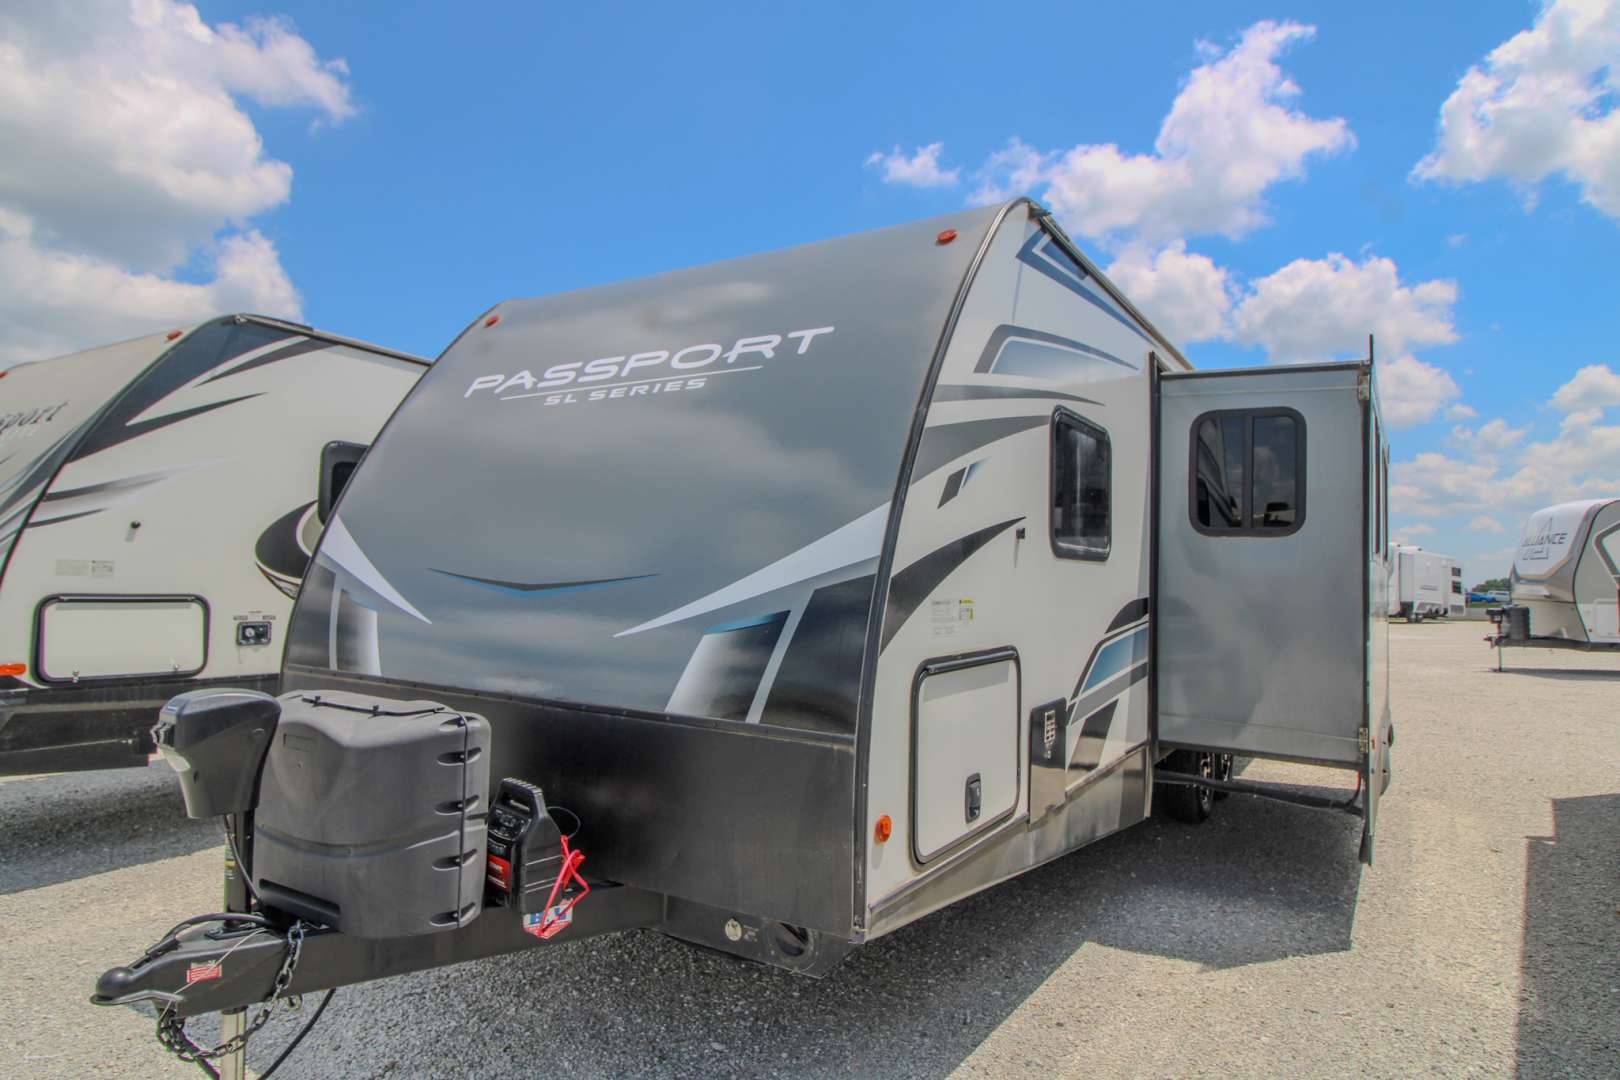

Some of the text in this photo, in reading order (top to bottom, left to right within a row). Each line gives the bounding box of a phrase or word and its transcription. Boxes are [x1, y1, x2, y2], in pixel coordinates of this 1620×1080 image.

[464, 326, 834, 398] PASSPORT
[544, 378, 707, 406] SL SERIES
